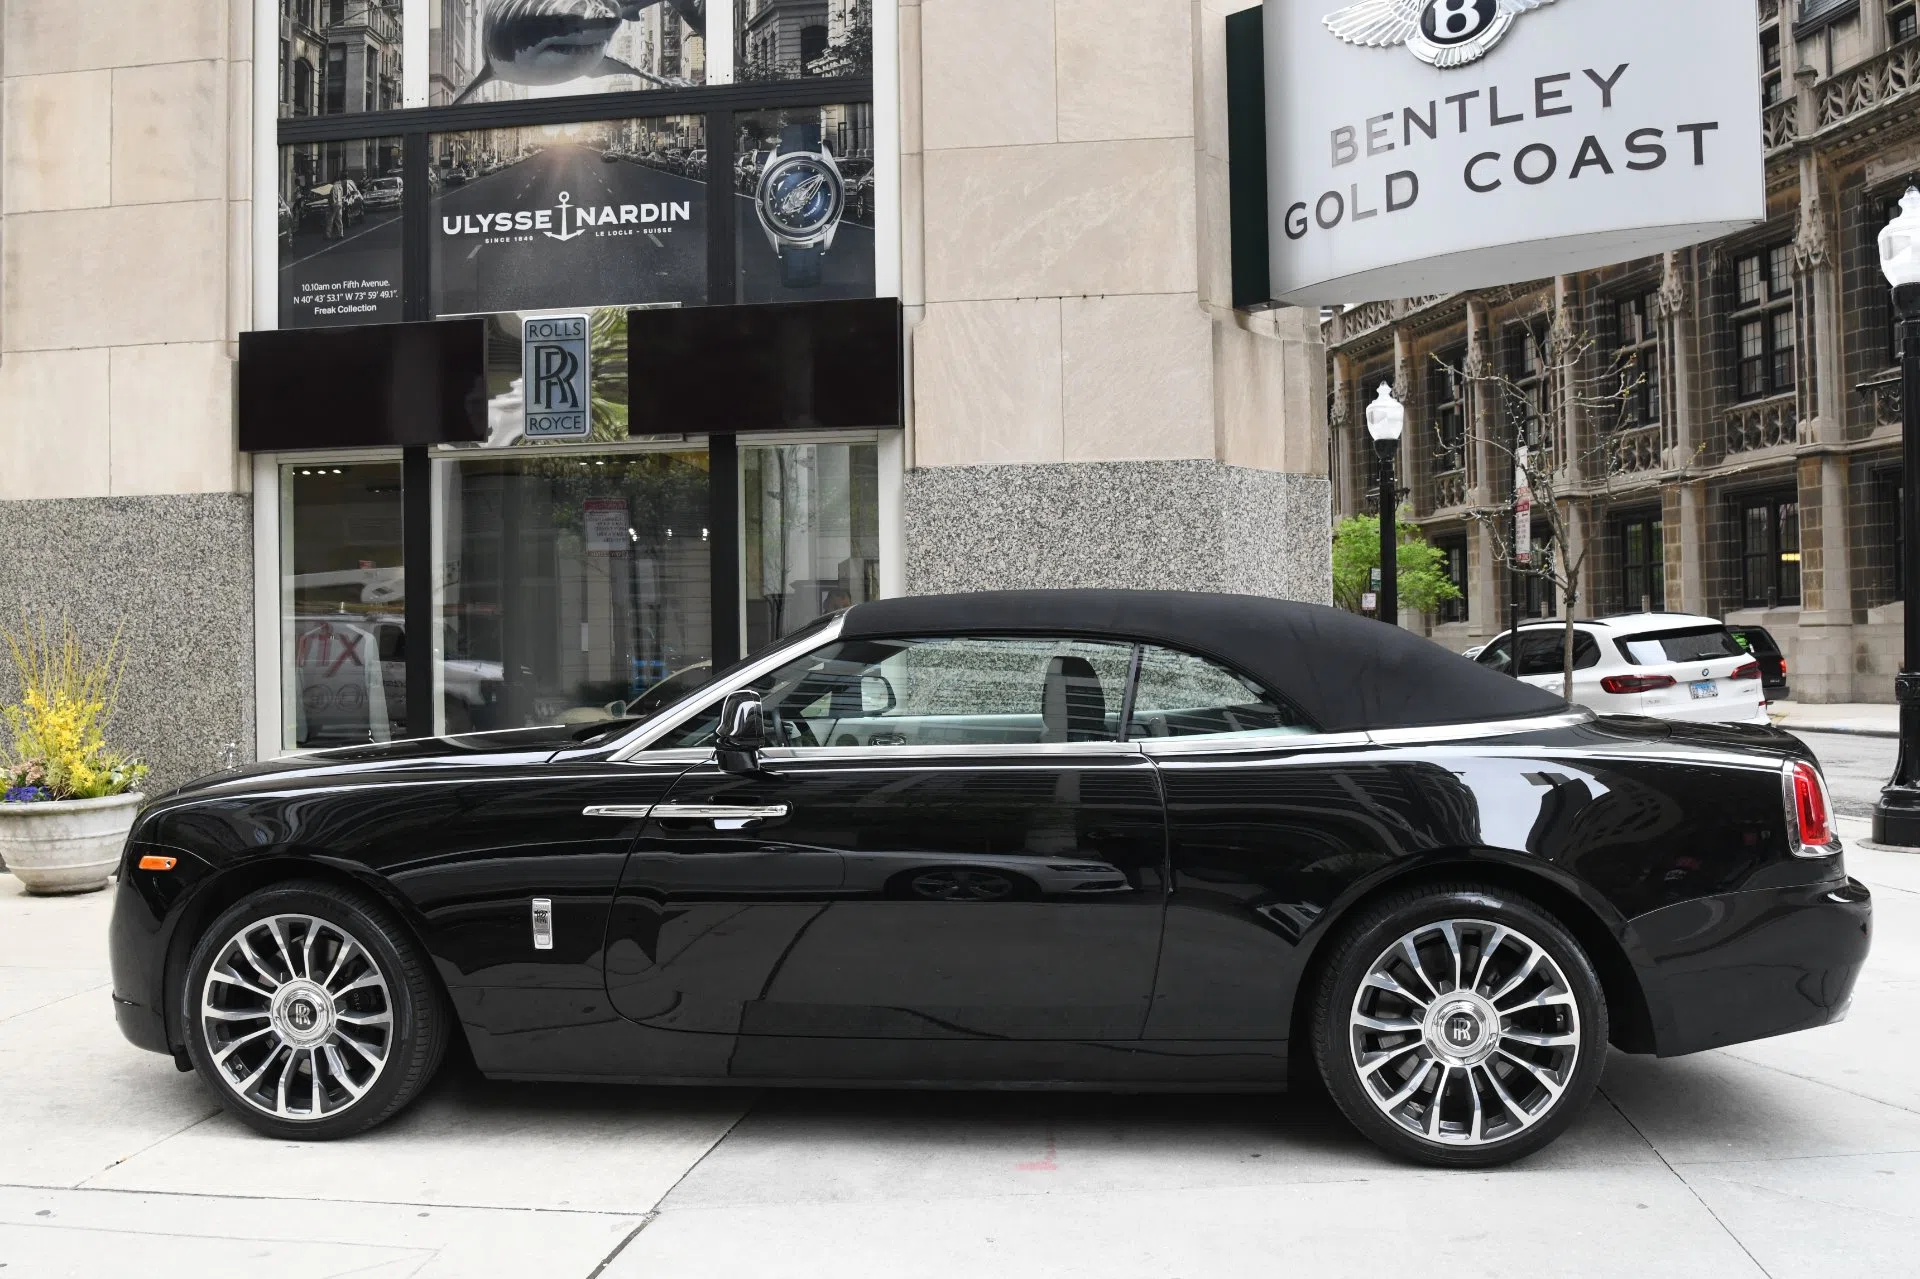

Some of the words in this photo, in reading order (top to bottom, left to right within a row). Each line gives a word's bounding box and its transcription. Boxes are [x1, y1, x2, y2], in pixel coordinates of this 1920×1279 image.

[1331, 63, 1630, 168] BENTLEY
[1284, 170, 1420, 240] GOLD
[1463, 121, 1719, 193] COAST
[442, 209, 552, 235] ULYSSE
[576, 201, 690, 227] NARDIN
[608, 229, 633, 237] LOCLE
[643, 226, 673, 234] SUISSE
[484, 236, 511, 244] SINCE
[301, 283, 330, 292] 10.10am
[343, 280, 360, 289] Fifth
[360, 279, 391, 288] Avenue.
[293, 296, 300, 304] N
[344, 292, 353, 301] W
[314, 306, 337, 315] Freak
[337, 303, 377, 313] Collection
[529, 322, 582, 338] ROLLS
[529, 415, 582, 431] ROYCE
[295, 1003, 311, 1025] RR
[1453, 1017, 1471, 1041] RR
